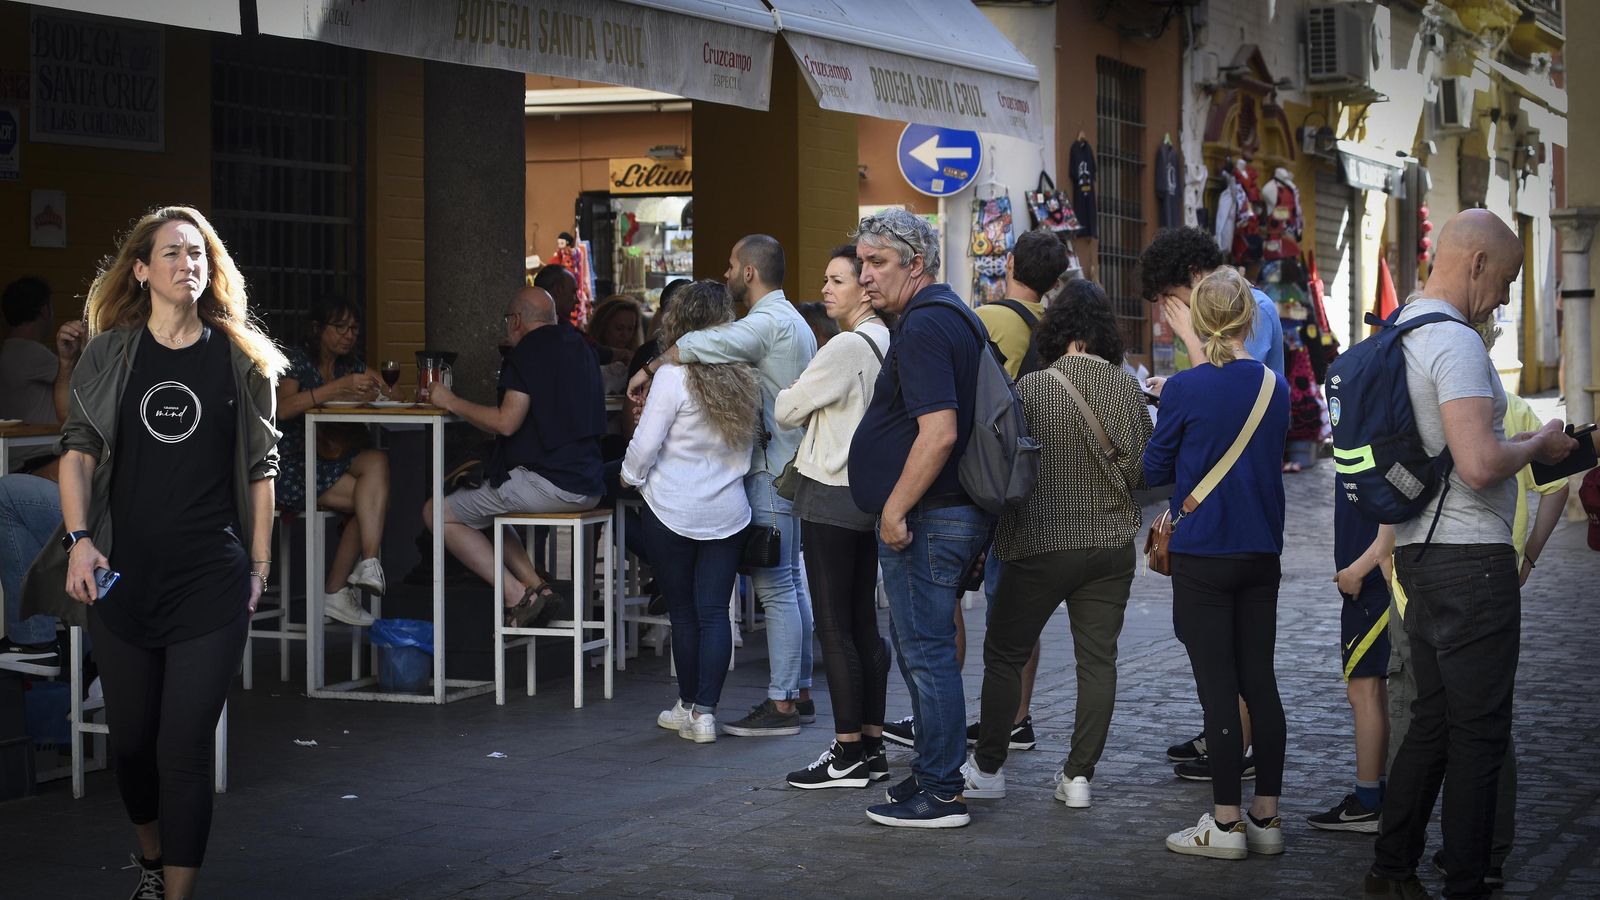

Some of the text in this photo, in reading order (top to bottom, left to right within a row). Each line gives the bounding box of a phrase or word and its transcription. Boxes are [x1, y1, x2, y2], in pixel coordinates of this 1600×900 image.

[33, 17, 124, 68] BODEGA
[454, 0, 645, 69] BODEGA SANTA CRUZ
[703, 41, 753, 75] Cruzcampo
[804, 54, 853, 84] Cruzcampo
[39, 64, 98, 107] SANTA
[102, 71, 157, 113] CRUZ
[868, 66, 987, 118] BODEGA SANTA CRUZ
[0, 127, 14, 144] DT
[50, 107, 77, 131] LAS
